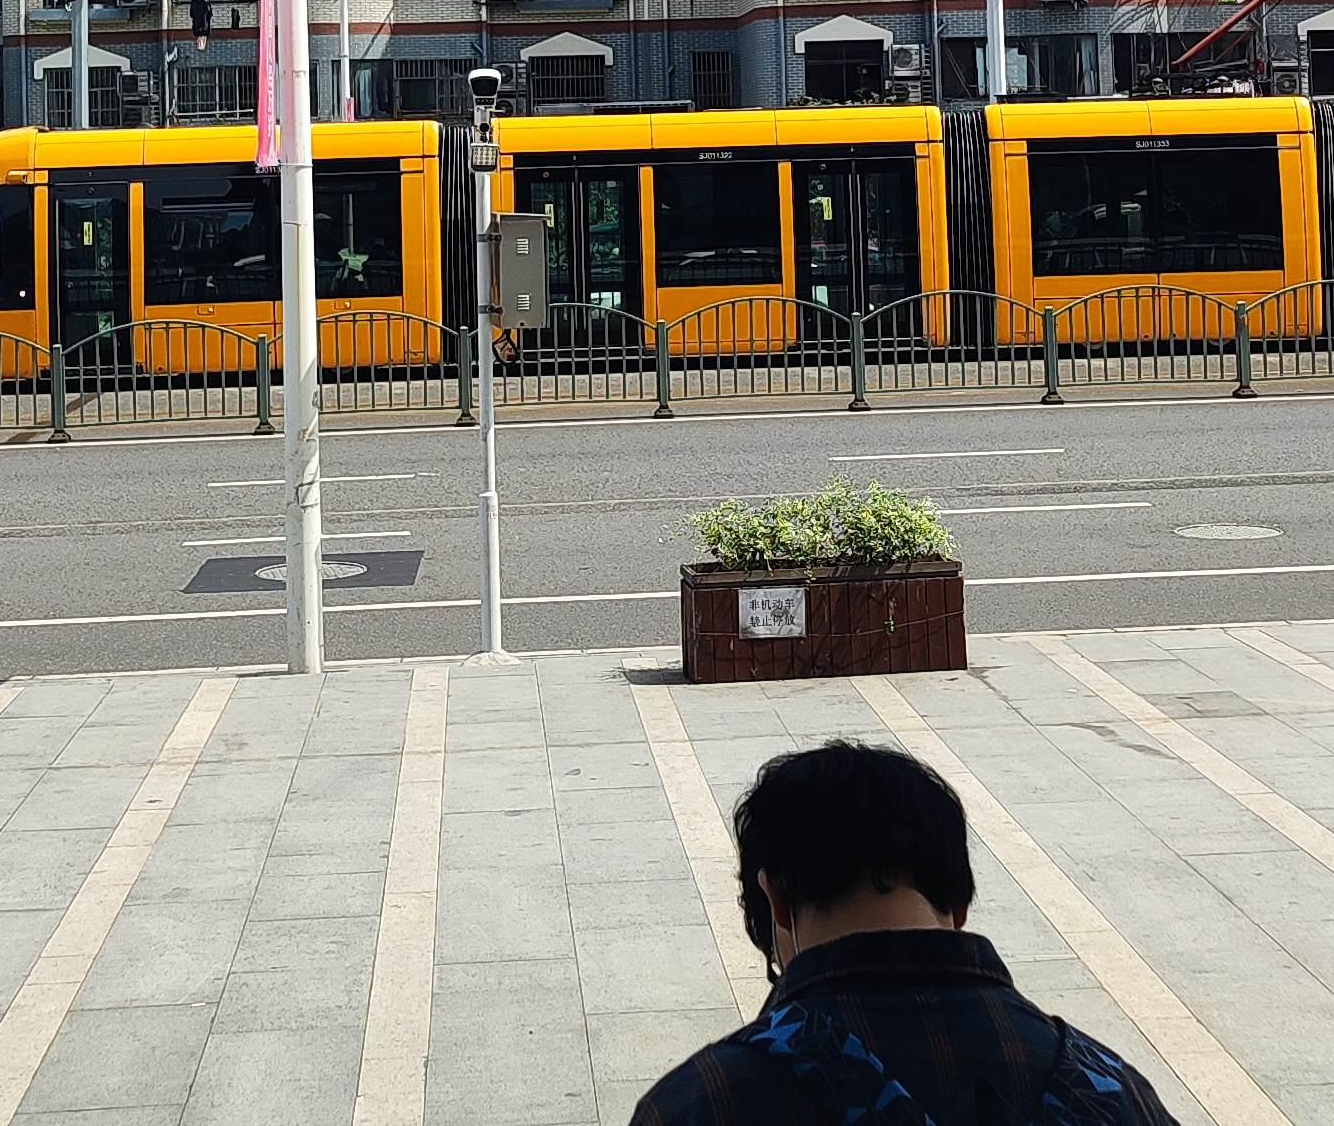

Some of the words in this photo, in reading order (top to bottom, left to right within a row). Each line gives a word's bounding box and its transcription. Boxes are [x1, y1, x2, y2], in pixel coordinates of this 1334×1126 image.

[748, 599, 795, 610] 非机动车
[749, 614, 796, 627] 禁止停放
